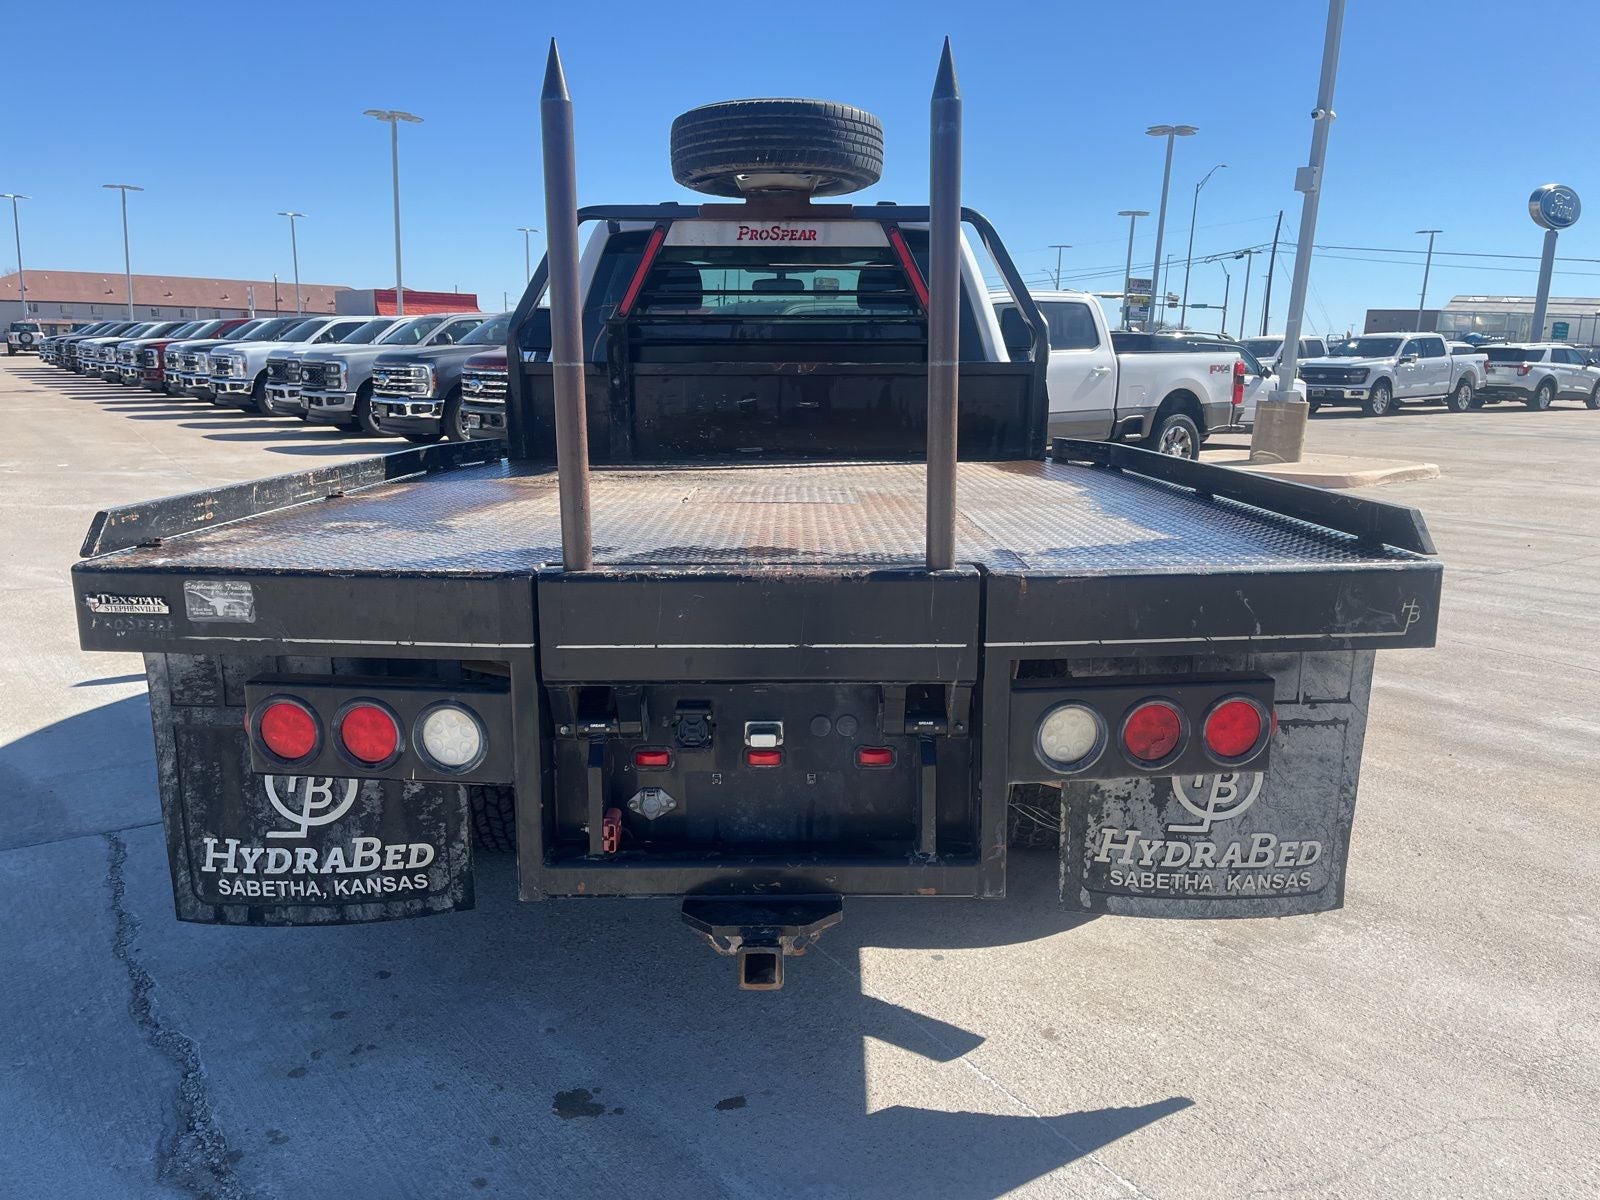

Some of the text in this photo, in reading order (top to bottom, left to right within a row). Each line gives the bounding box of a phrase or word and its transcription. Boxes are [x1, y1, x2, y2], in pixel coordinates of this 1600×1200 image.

[104, 605, 164, 613] STEPHENVILLE
[218, 873, 428, 899] SABETHA, KANSAS
[1110, 869, 1312, 893] SABETHA, KANSAS
